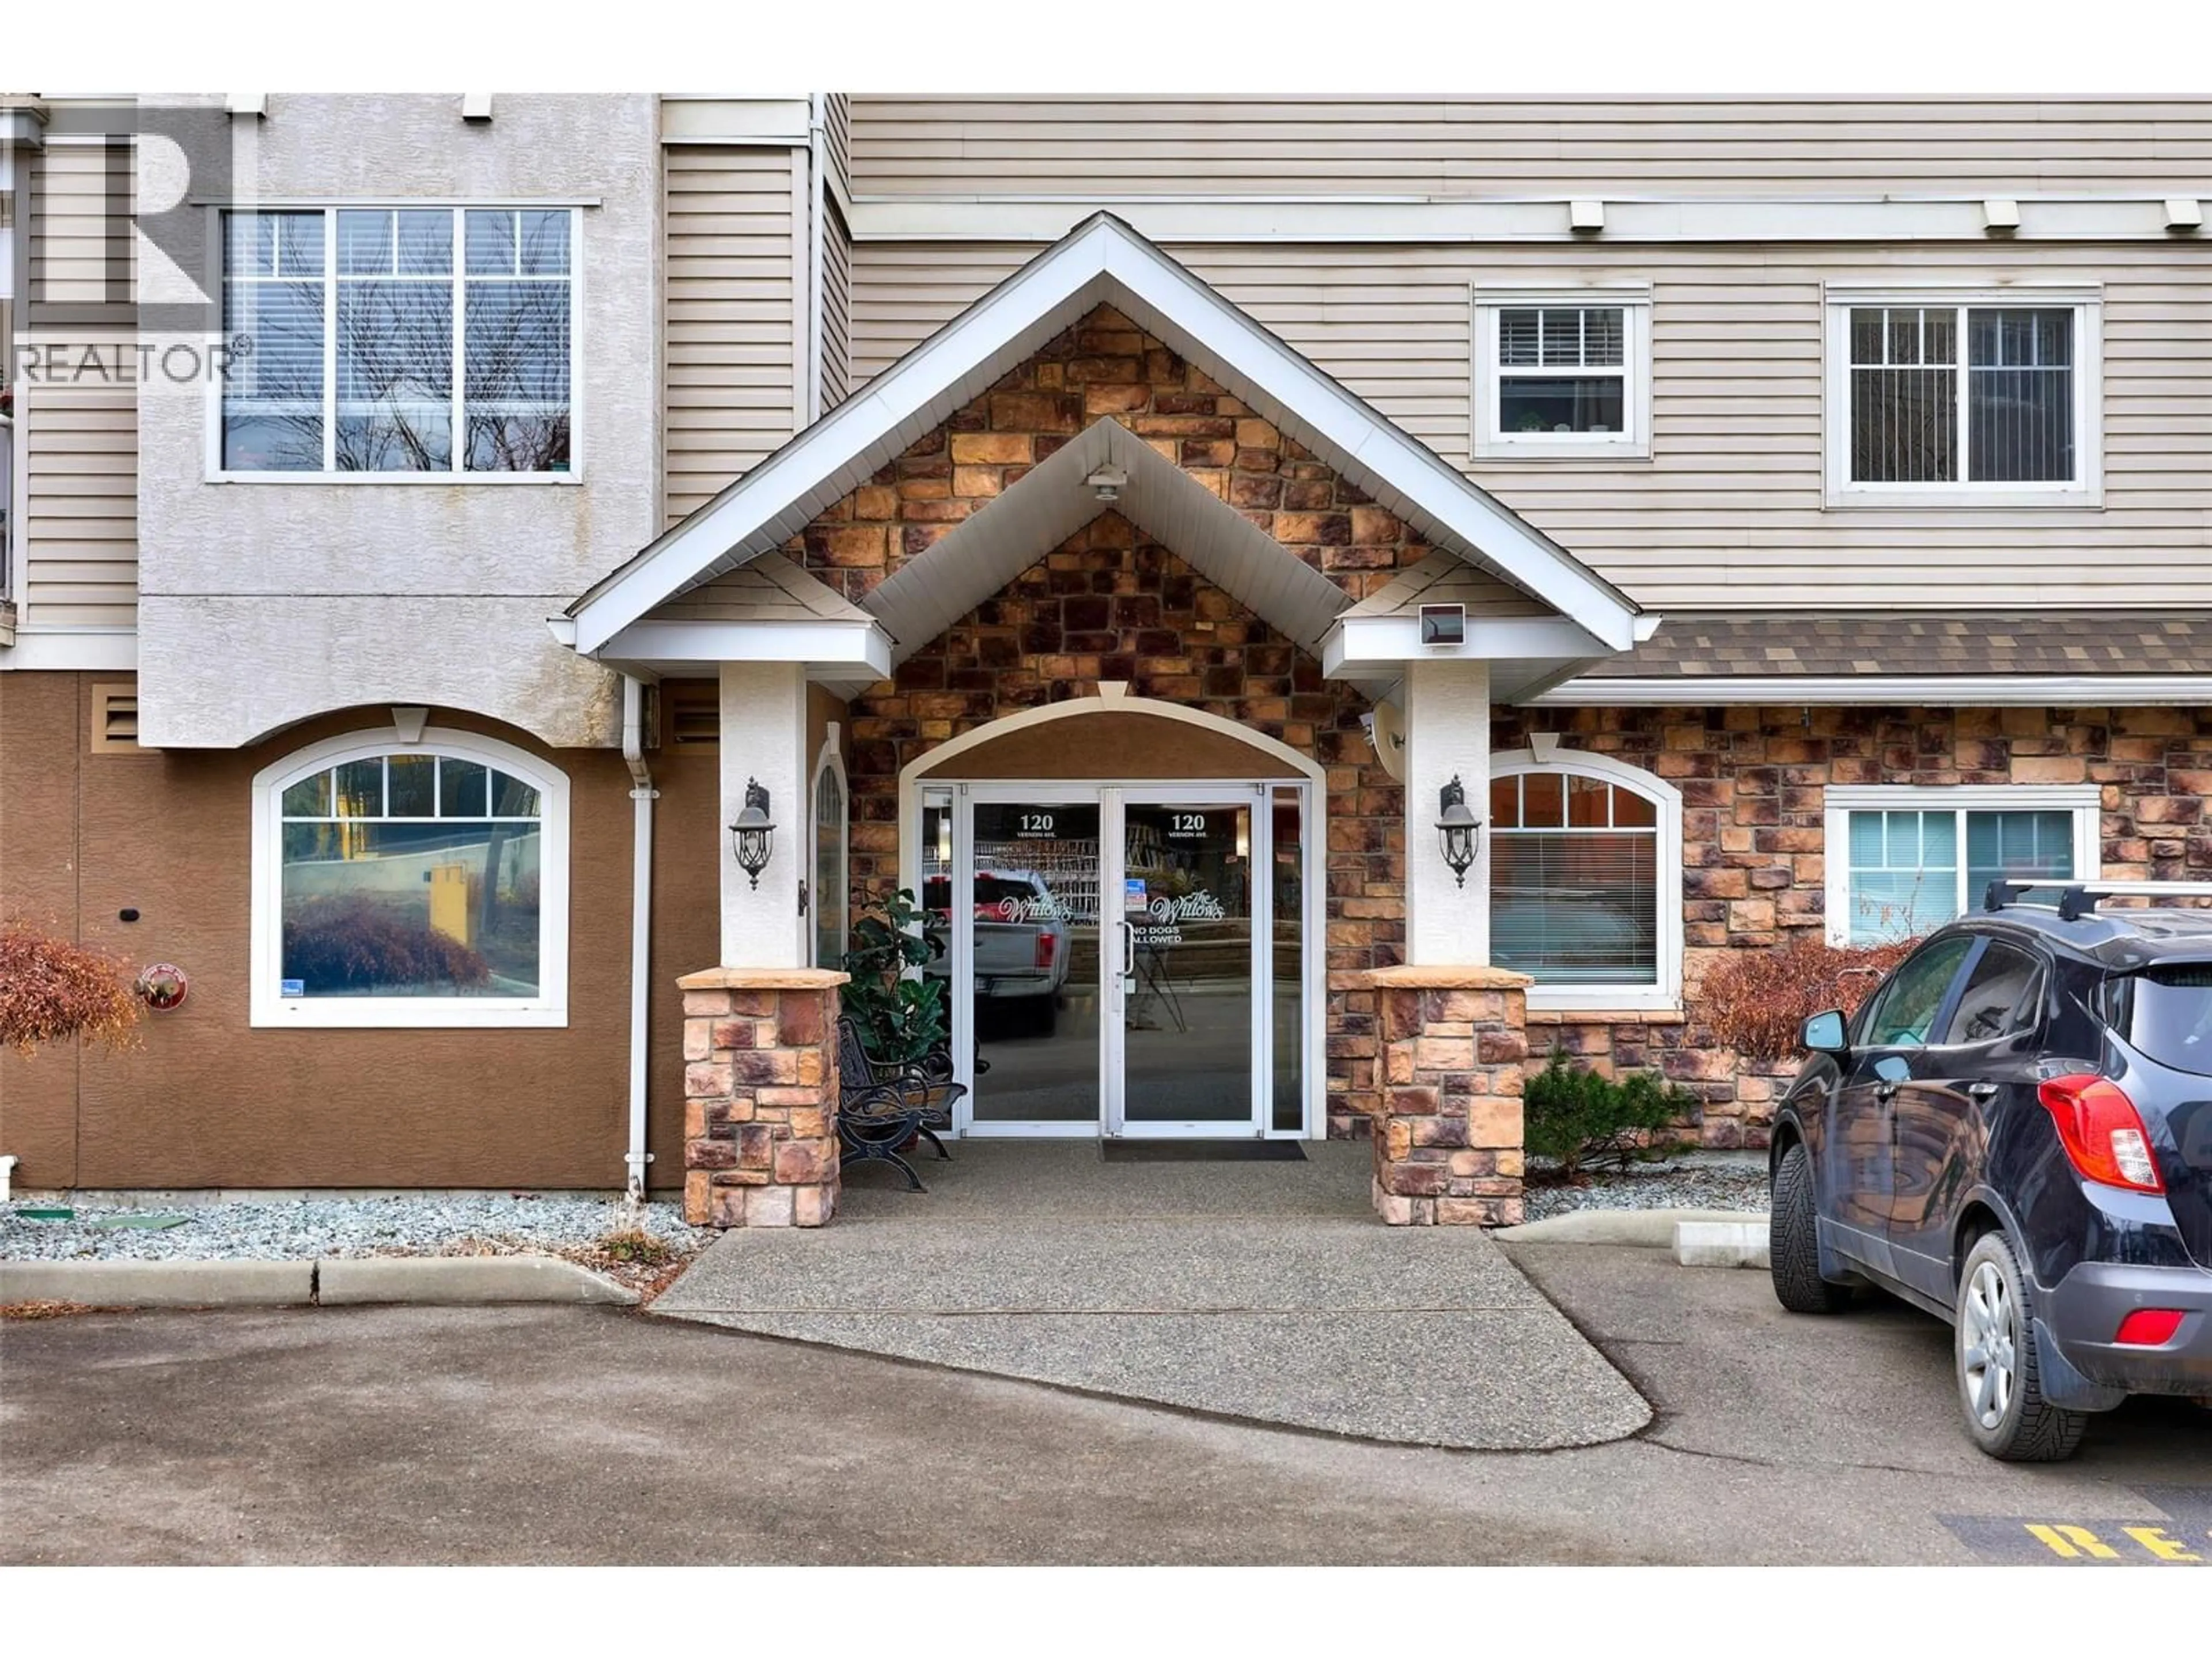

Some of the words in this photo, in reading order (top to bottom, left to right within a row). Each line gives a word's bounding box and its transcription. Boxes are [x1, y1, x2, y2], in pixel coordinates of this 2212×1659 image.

[1020, 815, 1053, 830] 120
[1172, 814, 1205, 830] 120
[1191, 888, 1219, 904] The
[998, 896, 1073, 925] Willows
[1150, 896, 1225, 925] Willows
[1149, 926, 1179, 934] DOGS
[1132, 935, 1181, 944] ALLOWED
[2023, 1524, 2212, 1562] RE
